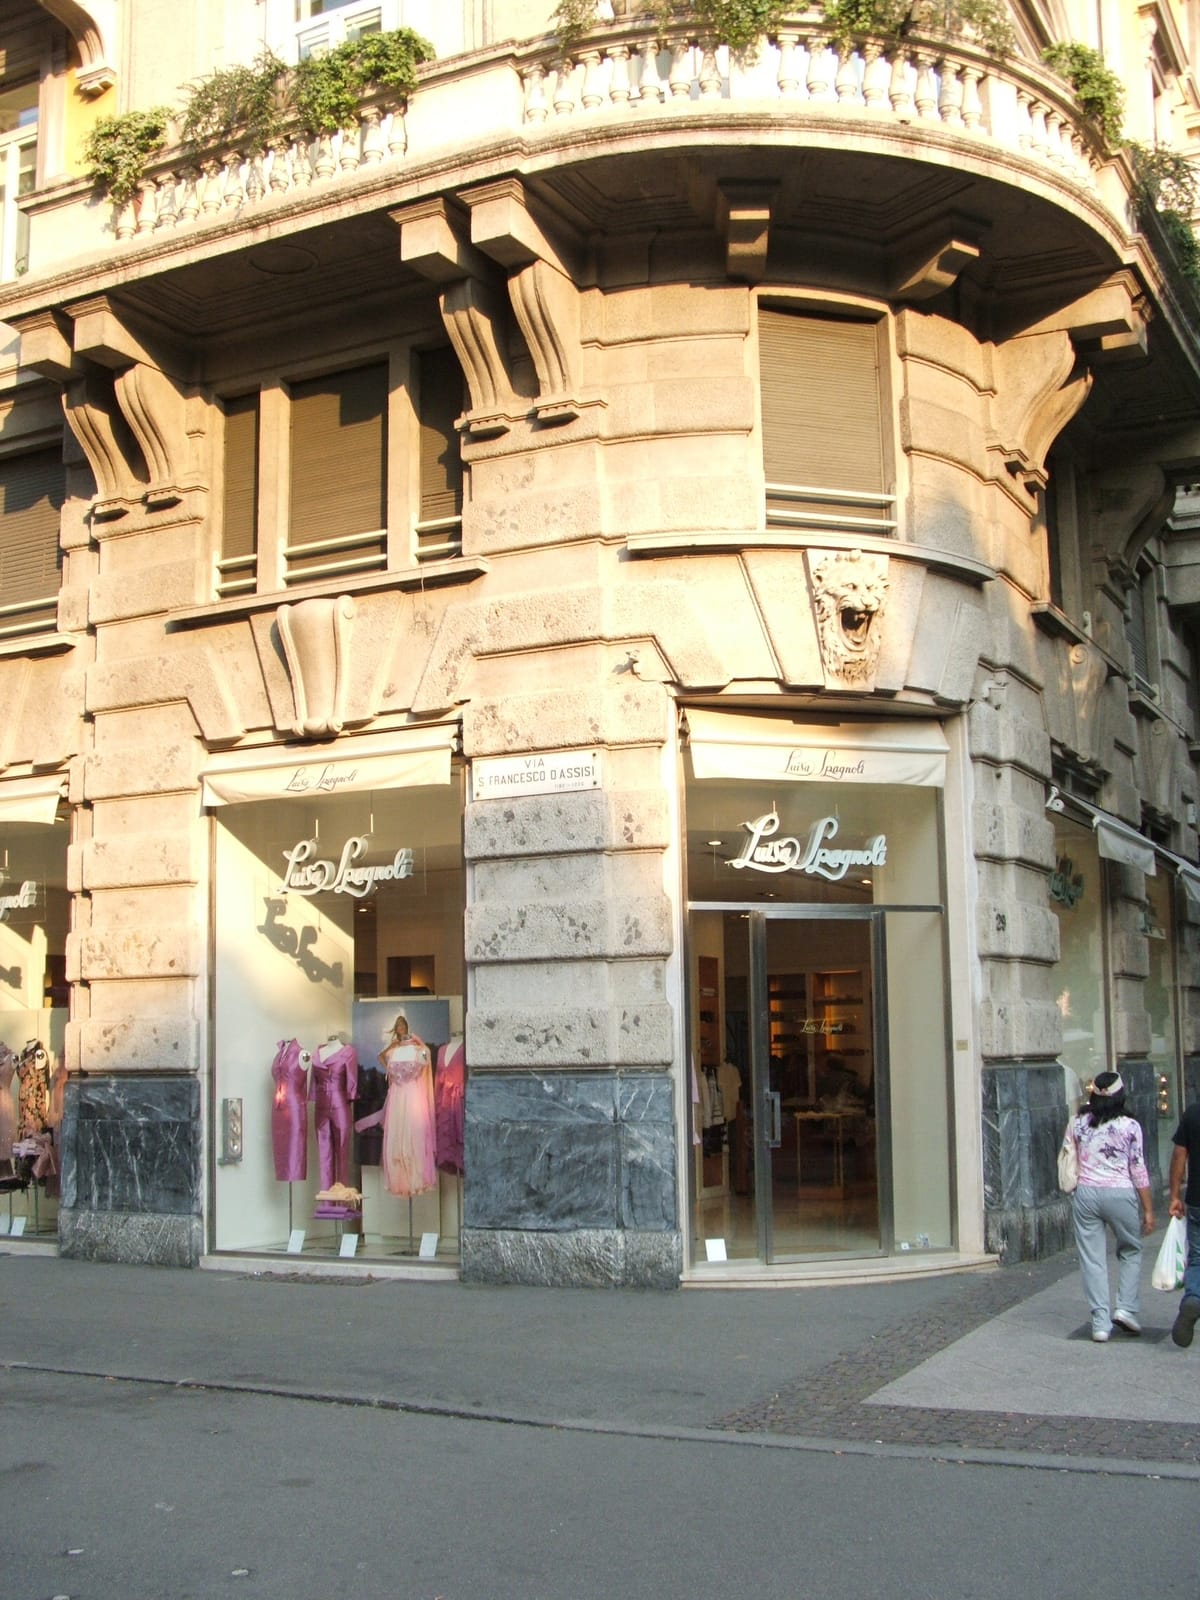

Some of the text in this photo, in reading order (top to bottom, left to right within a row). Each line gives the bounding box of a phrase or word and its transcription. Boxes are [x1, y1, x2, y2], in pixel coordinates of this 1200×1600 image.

[489, 770, 546, 786] FRANCESCO
[524, 758, 545, 769] VIA
[783, 749, 865, 780] Luisa Spagnoli
[724, 812, 887, 881] Luisa Spagnoli
[277, 836, 414, 898] Luisa Spagnoli
